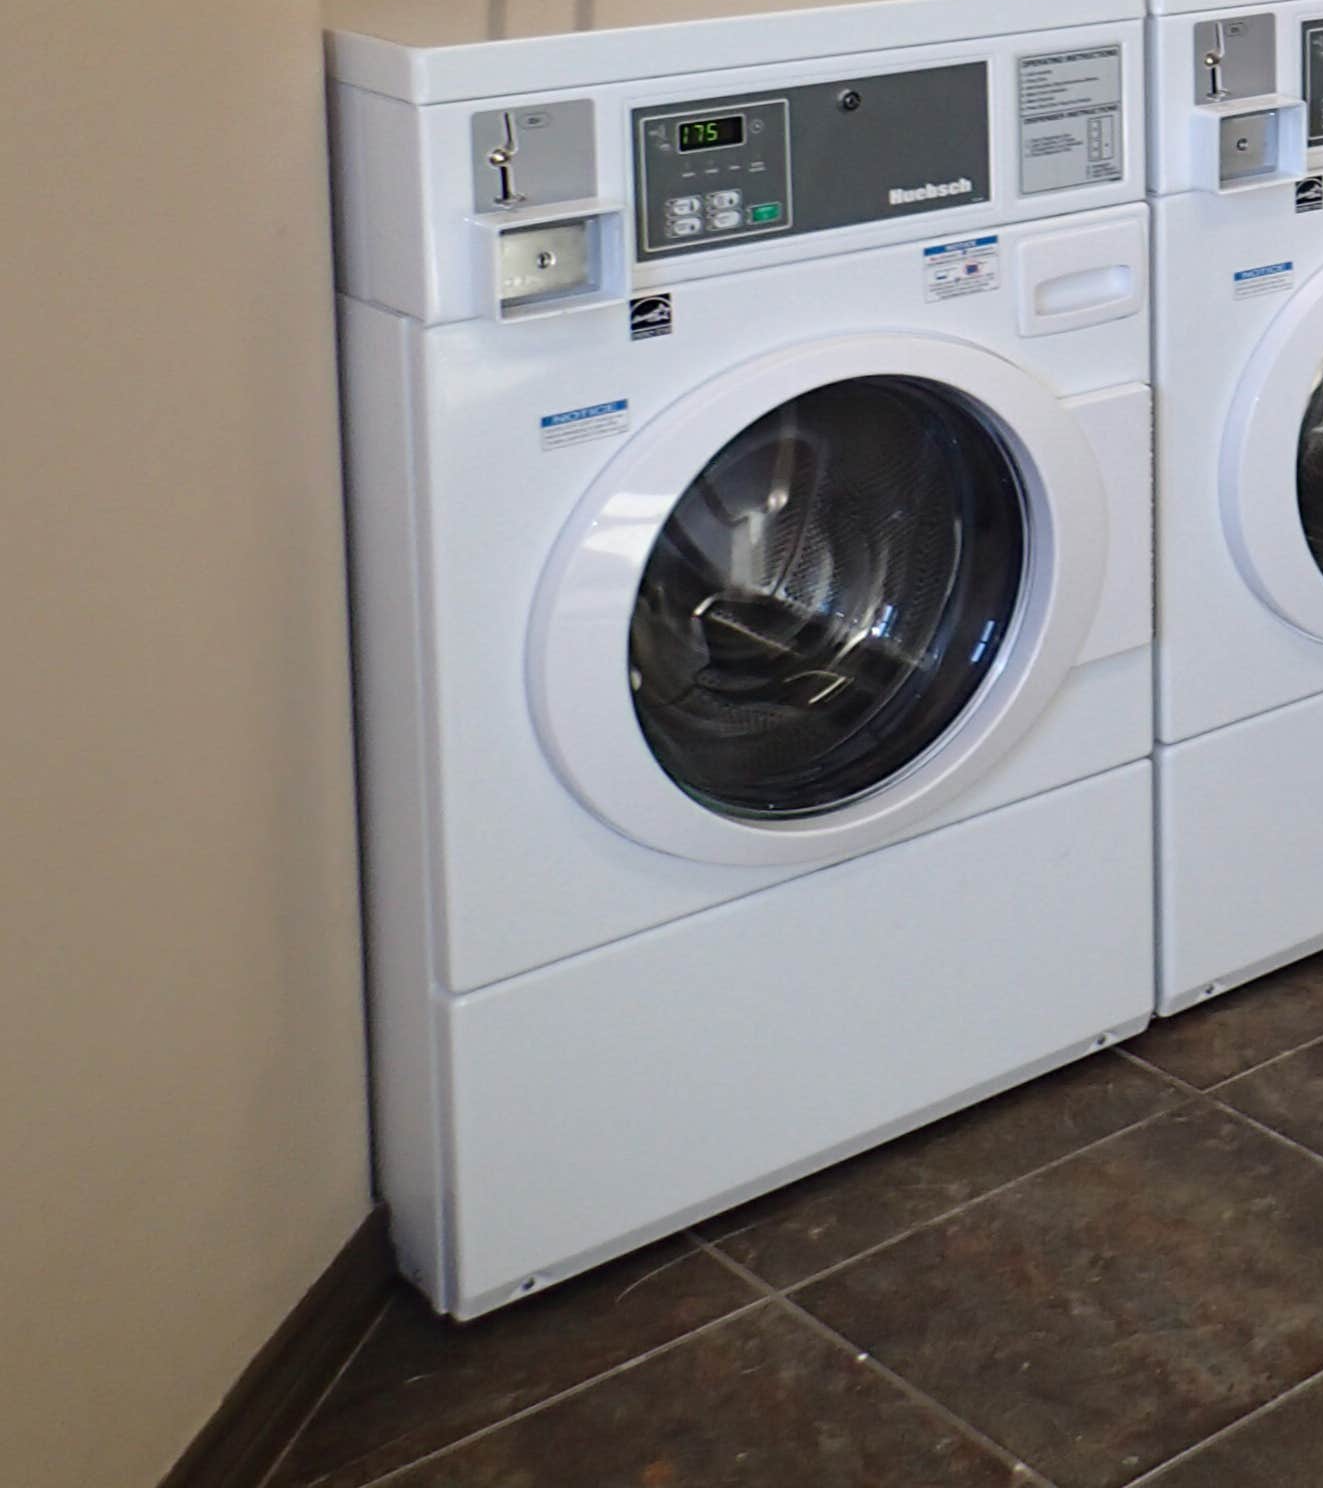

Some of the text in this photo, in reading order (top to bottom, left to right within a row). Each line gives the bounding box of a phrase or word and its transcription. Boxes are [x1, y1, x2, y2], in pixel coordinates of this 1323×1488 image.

[681, 121, 720, 146] 175
[888, 176, 973, 205] Huebsch
[551, 401, 614, 425] NOTICE
